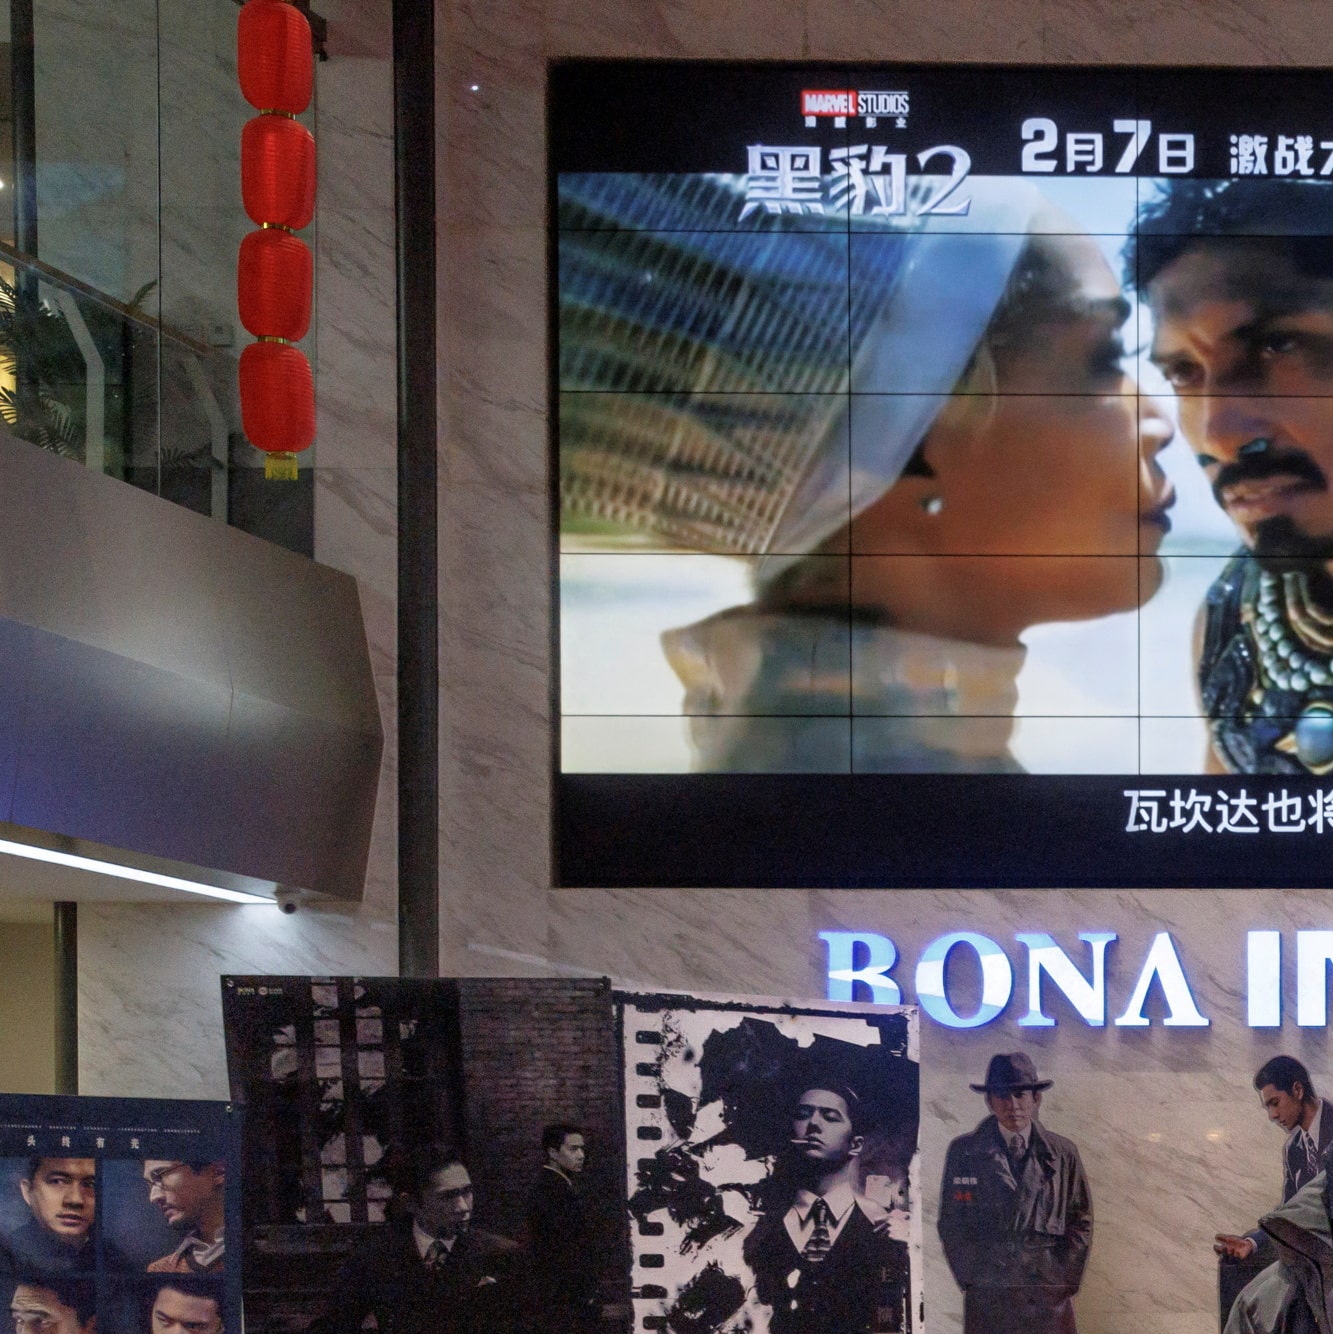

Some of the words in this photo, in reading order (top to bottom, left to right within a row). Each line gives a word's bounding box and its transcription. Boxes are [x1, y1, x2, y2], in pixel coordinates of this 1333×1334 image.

[804, 94, 855, 113] MARVEL
[858, 94, 909, 113] STUDIOS
[1021, 117, 1195, 174] 2月7日
[738, 144, 972, 216] 黑豹2
[818, 930, 1209, 1028] BONA
